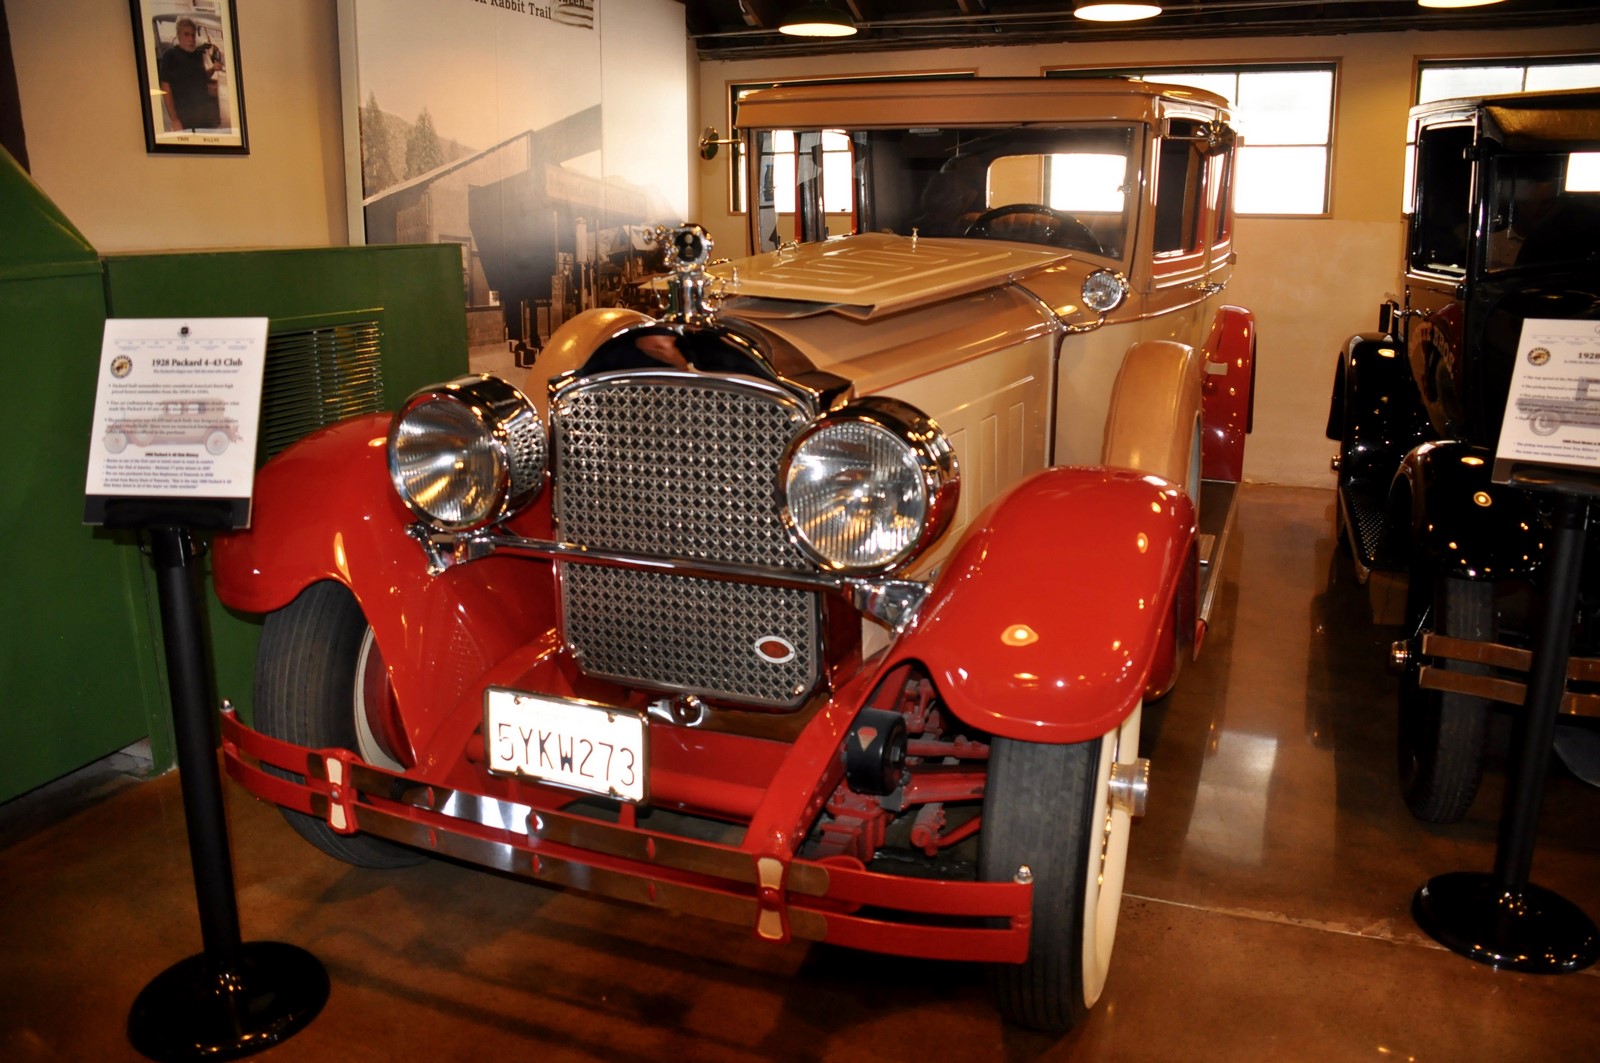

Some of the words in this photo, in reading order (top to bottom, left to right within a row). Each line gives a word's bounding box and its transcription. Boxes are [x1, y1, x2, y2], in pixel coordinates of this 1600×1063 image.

[527, 2, 551, 20] Trail
[152, 358, 170, 367] 1928
[171, 357, 203, 367] Packard
[203, 358, 222, 367] 4-43
[223, 358, 243, 368] Club
[498, 722, 634, 786] 5YKW273
